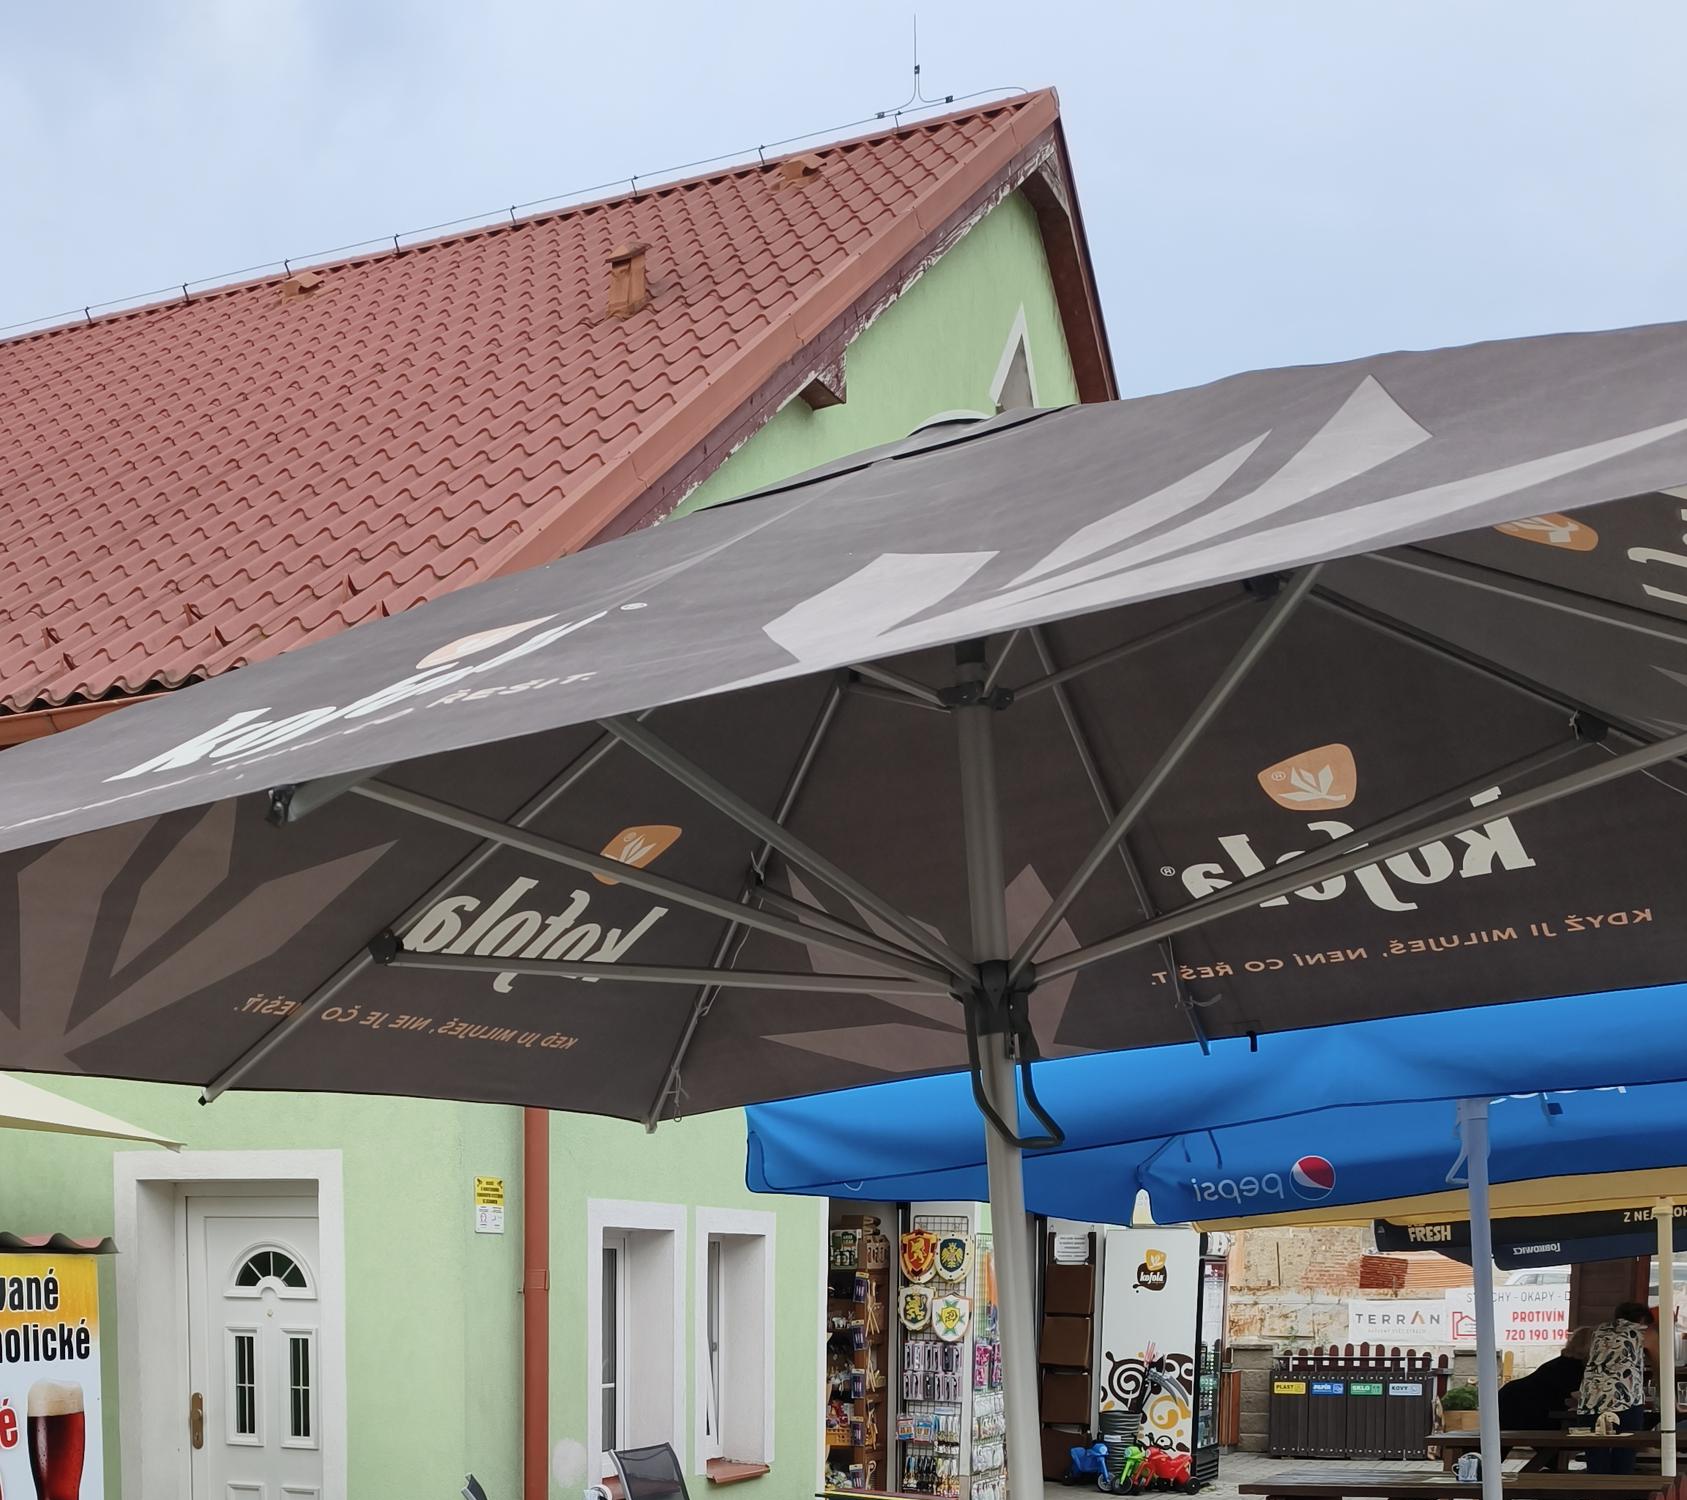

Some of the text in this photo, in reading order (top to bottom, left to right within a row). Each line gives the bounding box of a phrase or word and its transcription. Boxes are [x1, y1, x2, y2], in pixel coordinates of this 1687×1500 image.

[1623, 1211, 1631, 1223] Z
[1407, 1224, 1452, 1242] FRESH
[1140, 1271, 1164, 1284] kofola
[1520, 1291, 1554, 1302] OKAPY
[1512, 1308, 1565, 1323] PROTIVÍN
[0, 1318, 91, 1364] olické
[1505, 1329, 1525, 1341] 720
[1529, 1329, 1548, 1341] 190
